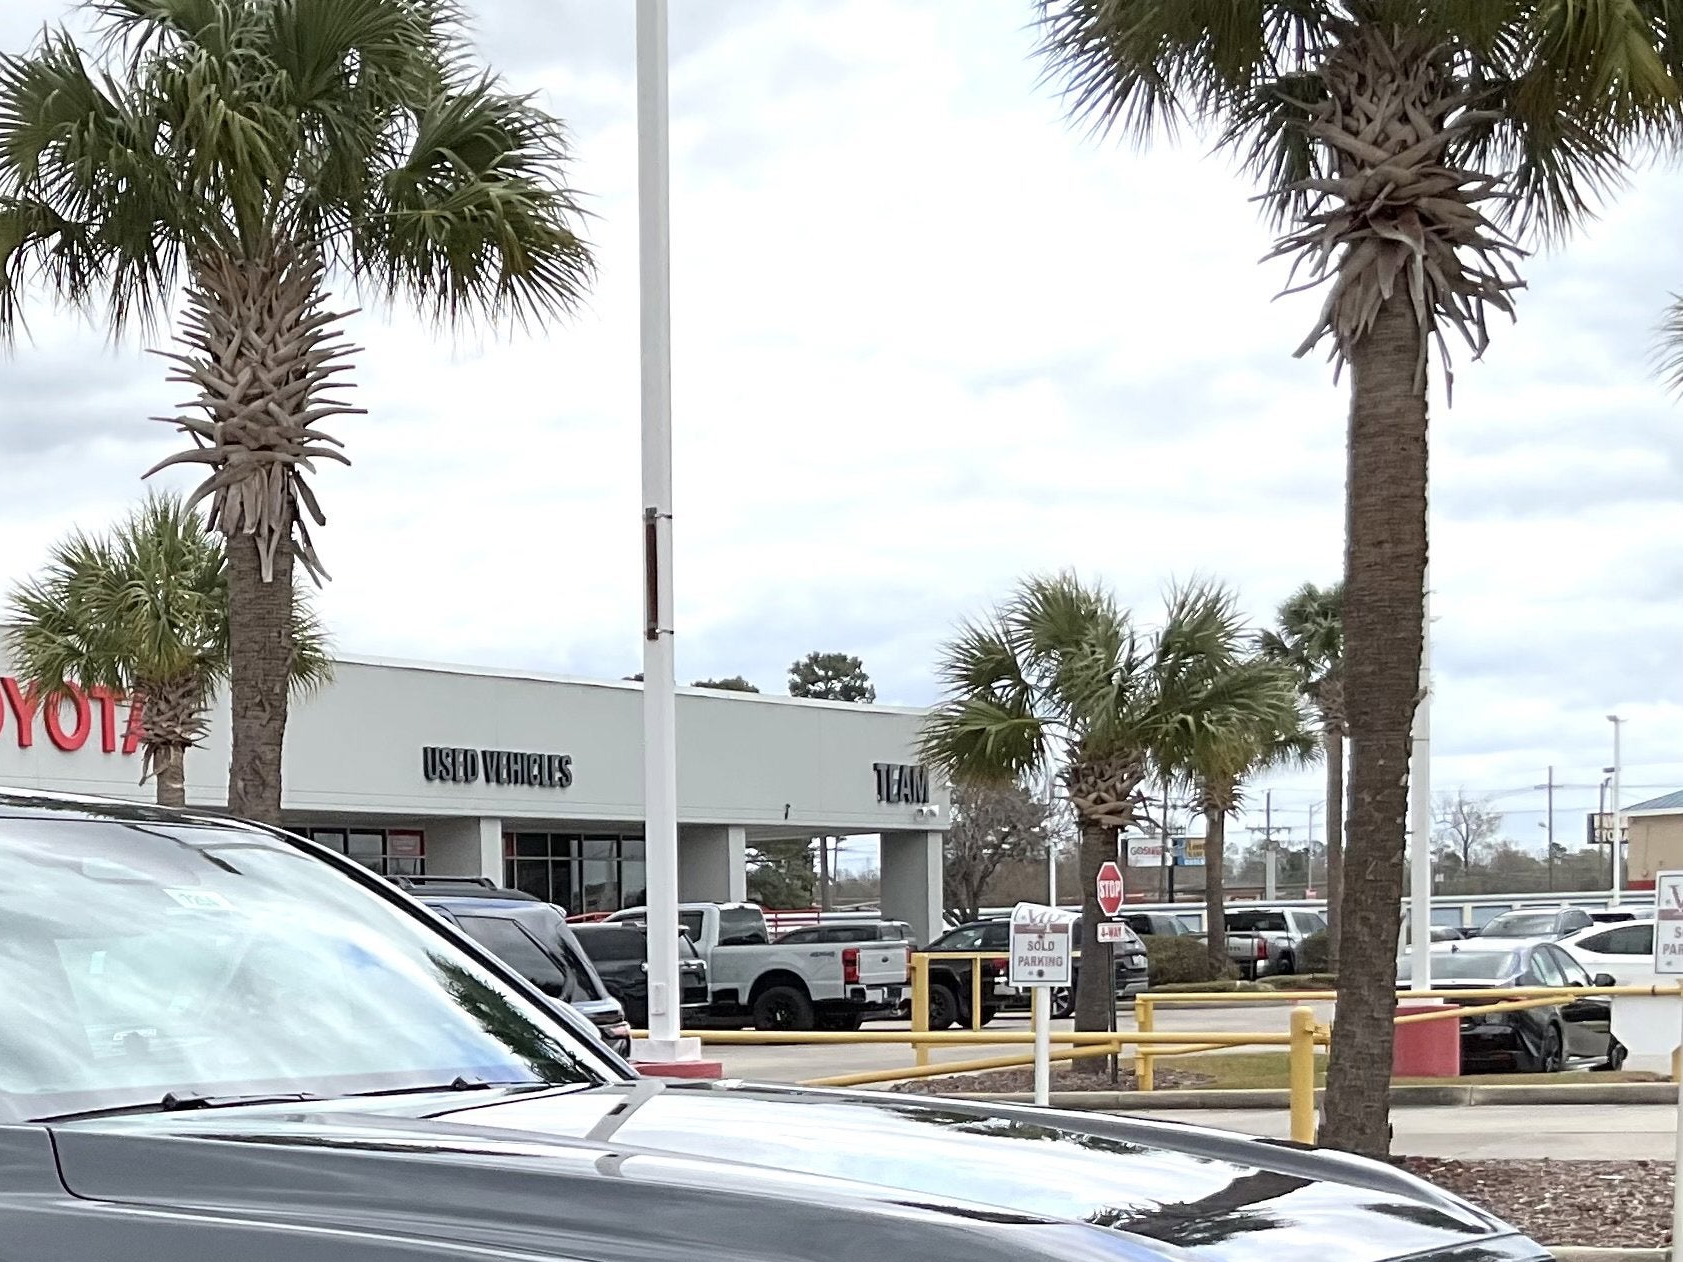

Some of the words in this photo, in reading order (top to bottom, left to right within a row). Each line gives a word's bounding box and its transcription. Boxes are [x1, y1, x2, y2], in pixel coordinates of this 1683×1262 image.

[423, 746, 479, 783] USED
[481, 750, 573, 788] VEHICLES
[873, 763, 930, 804] TEAM
[1099, 880, 1121, 898] STOP
[1101, 927, 1122, 938] 4-WAY
[1027, 941, 1055, 952] SOLD
[1018, 956, 1063, 967] PARKING
